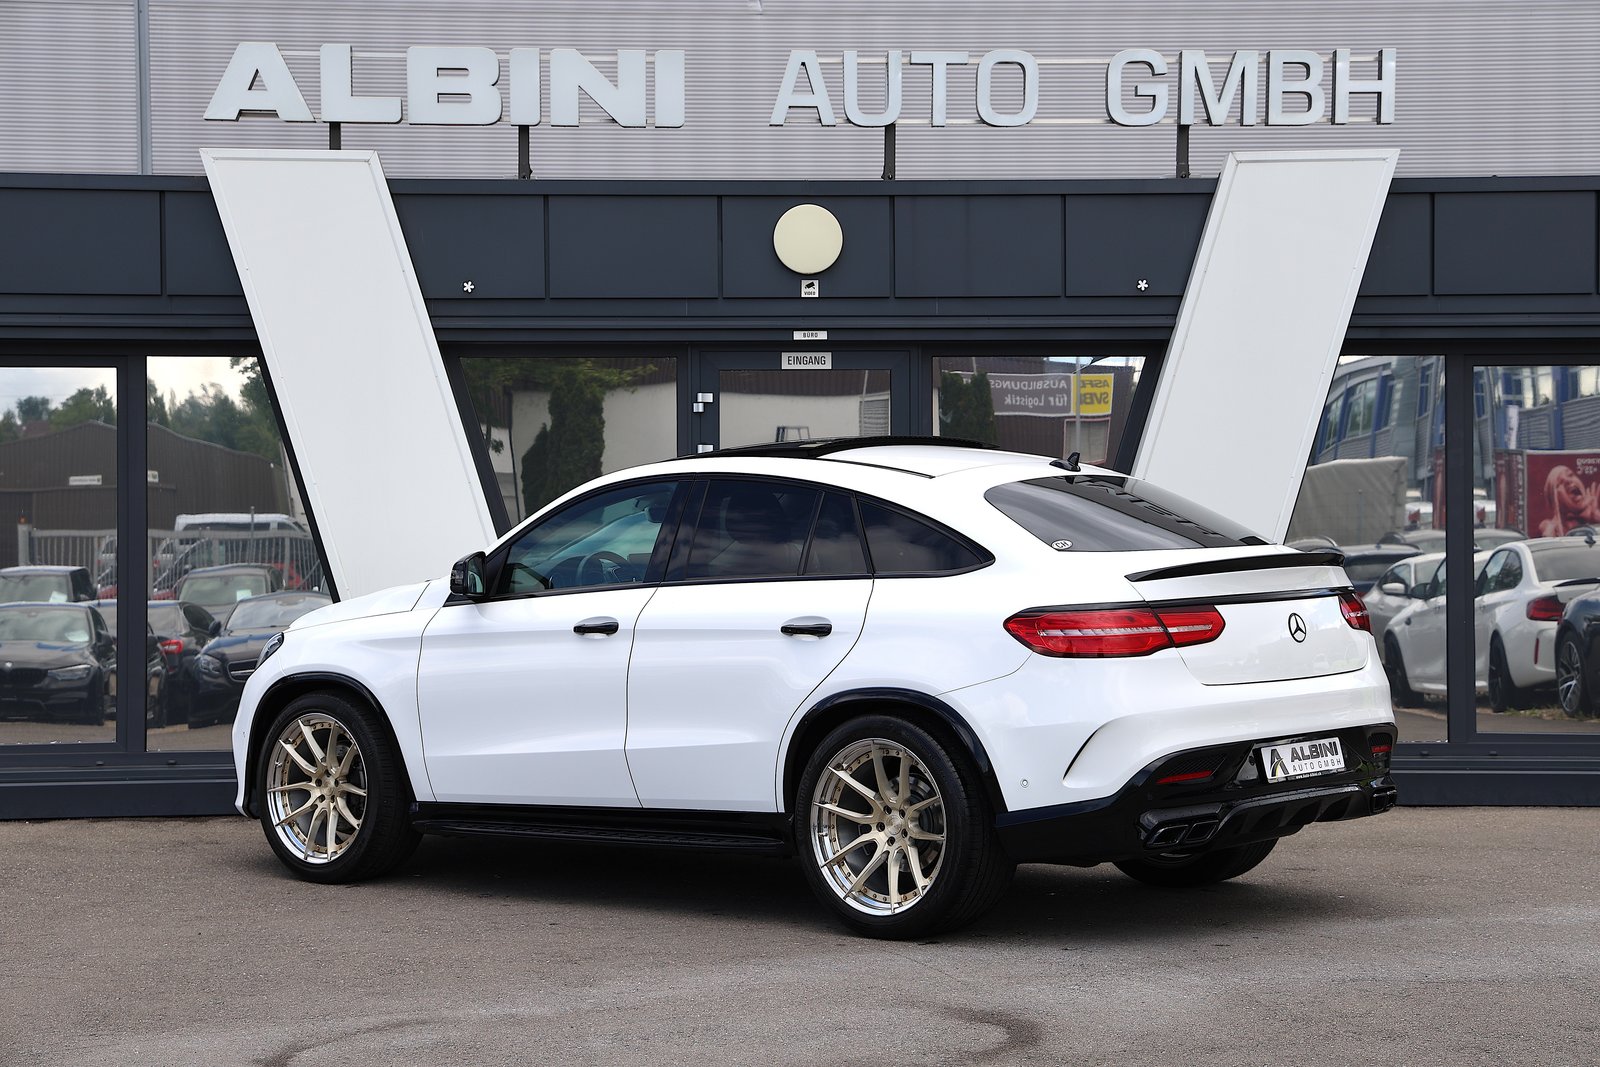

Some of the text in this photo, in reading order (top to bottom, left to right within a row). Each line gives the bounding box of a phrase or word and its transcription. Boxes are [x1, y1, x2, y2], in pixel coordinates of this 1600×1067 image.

[203, 42, 1397, 128] ALBINI AUTO GMBH
[787, 355, 826, 366] EINGANG
[1291, 741, 1338, 762] ALBINI
[1292, 758, 1342, 773] AUTO GMBH
